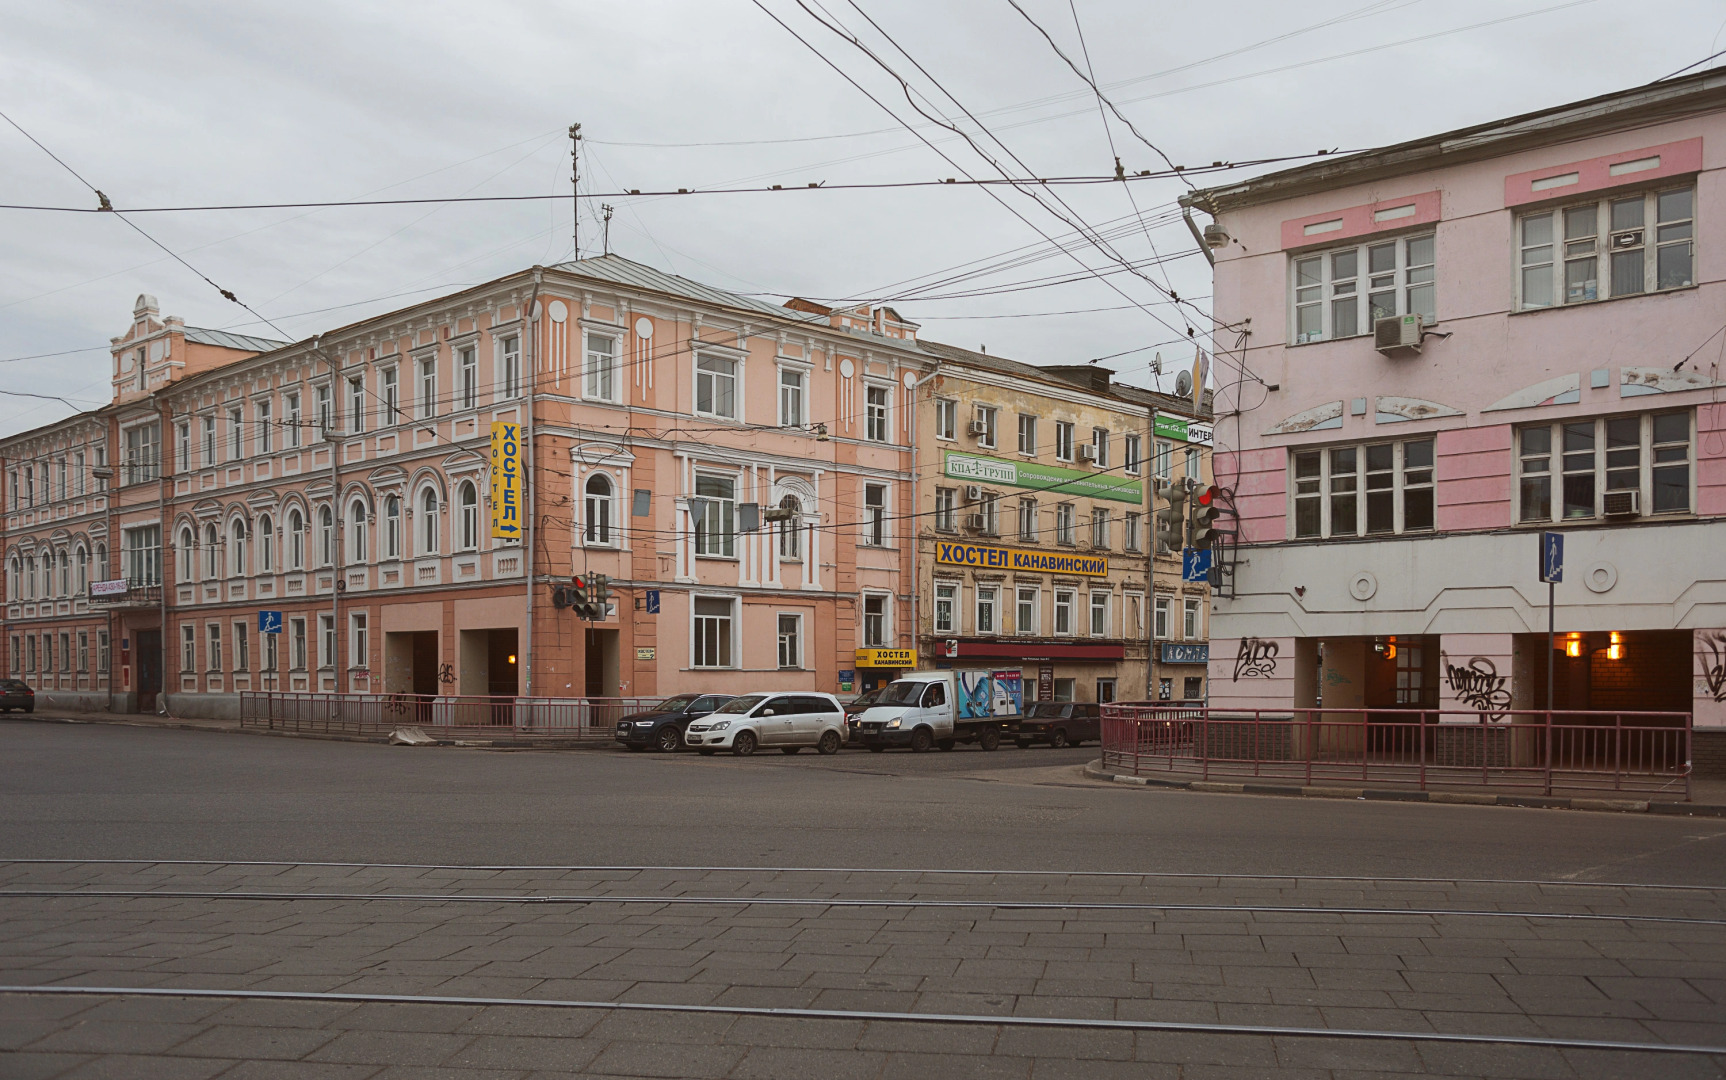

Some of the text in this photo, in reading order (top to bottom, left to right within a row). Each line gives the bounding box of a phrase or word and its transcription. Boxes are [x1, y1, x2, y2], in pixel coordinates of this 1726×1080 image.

[503, 425, 516, 520] ХОСТЕЛ
[941, 544, 1105, 574] ХОСТЕЛ КАНАВИНСКИЙ
[877, 651, 910, 659] ХОСТЕЛ
